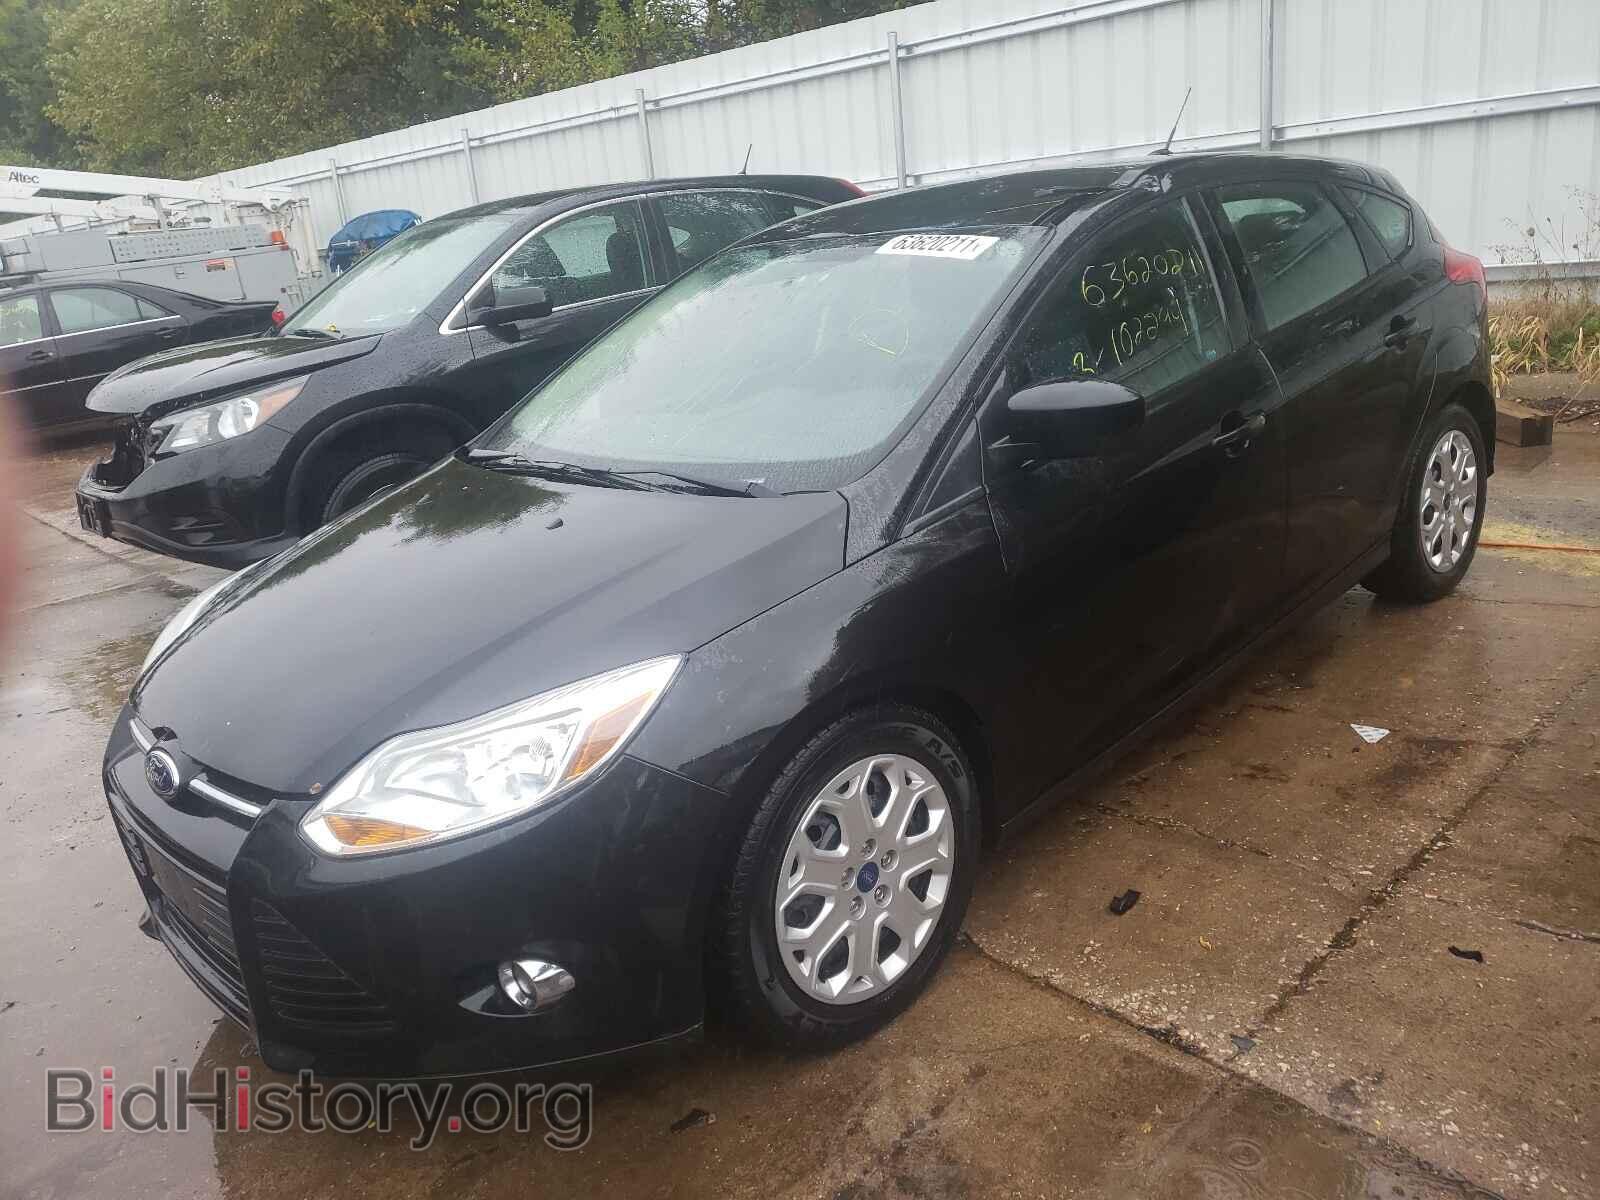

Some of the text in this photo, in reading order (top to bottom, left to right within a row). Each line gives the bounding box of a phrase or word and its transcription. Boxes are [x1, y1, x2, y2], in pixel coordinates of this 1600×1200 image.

[9, 171, 39, 184] Altec
[892, 235, 979, 253] 63620211
[1081, 246, 1205, 306] 63620211
